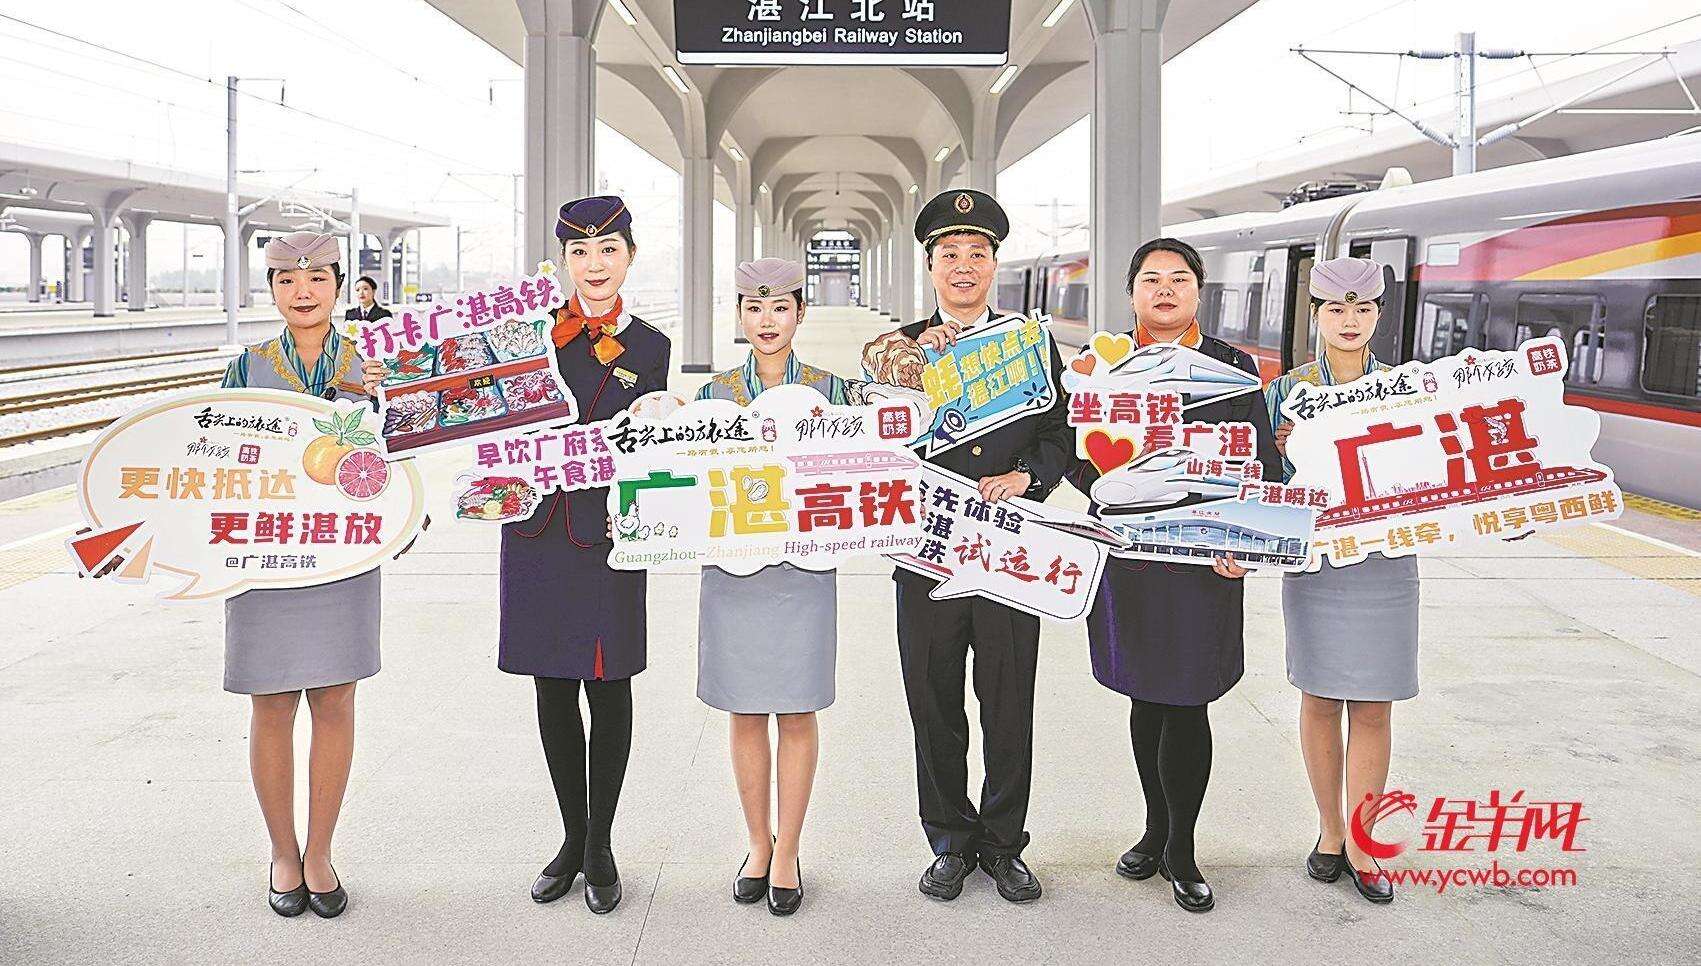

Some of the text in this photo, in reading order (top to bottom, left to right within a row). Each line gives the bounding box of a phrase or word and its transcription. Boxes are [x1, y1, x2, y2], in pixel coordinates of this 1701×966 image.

[747, 0, 935, 22] 湛江北站
[721, 27, 963, 46] Zhanjiangbei Railway Station
[361, 276, 560, 358] 打卡广湛高铁
[1070, 391, 1181, 424] 坐高铁
[1289, 372, 1418, 421] 舌尖上的旅途
[194, 406, 284, 434] 舌尖上的旅途
[607, 414, 755, 454] 舌尖上的旅途
[1143, 424, 1253, 457] 看广湛
[1333, 397, 1541, 506] 广湛
[118, 466, 297, 500] 更快抵达
[533, 455, 616, 490] 午食湛
[1186, 458, 1263, 480] 山海一线
[618, 464, 917, 538] 广湛高铁
[1239, 483, 1329, 508] 广湛瞬达
[208, 512, 383, 545] 更鲜湛放
[225, 554, 317, 570] @广湛高铁
[784, 536, 866, 557] High-speed
[870, 534, 923, 549] railway
[953, 532, 1083, 595] 试运行
